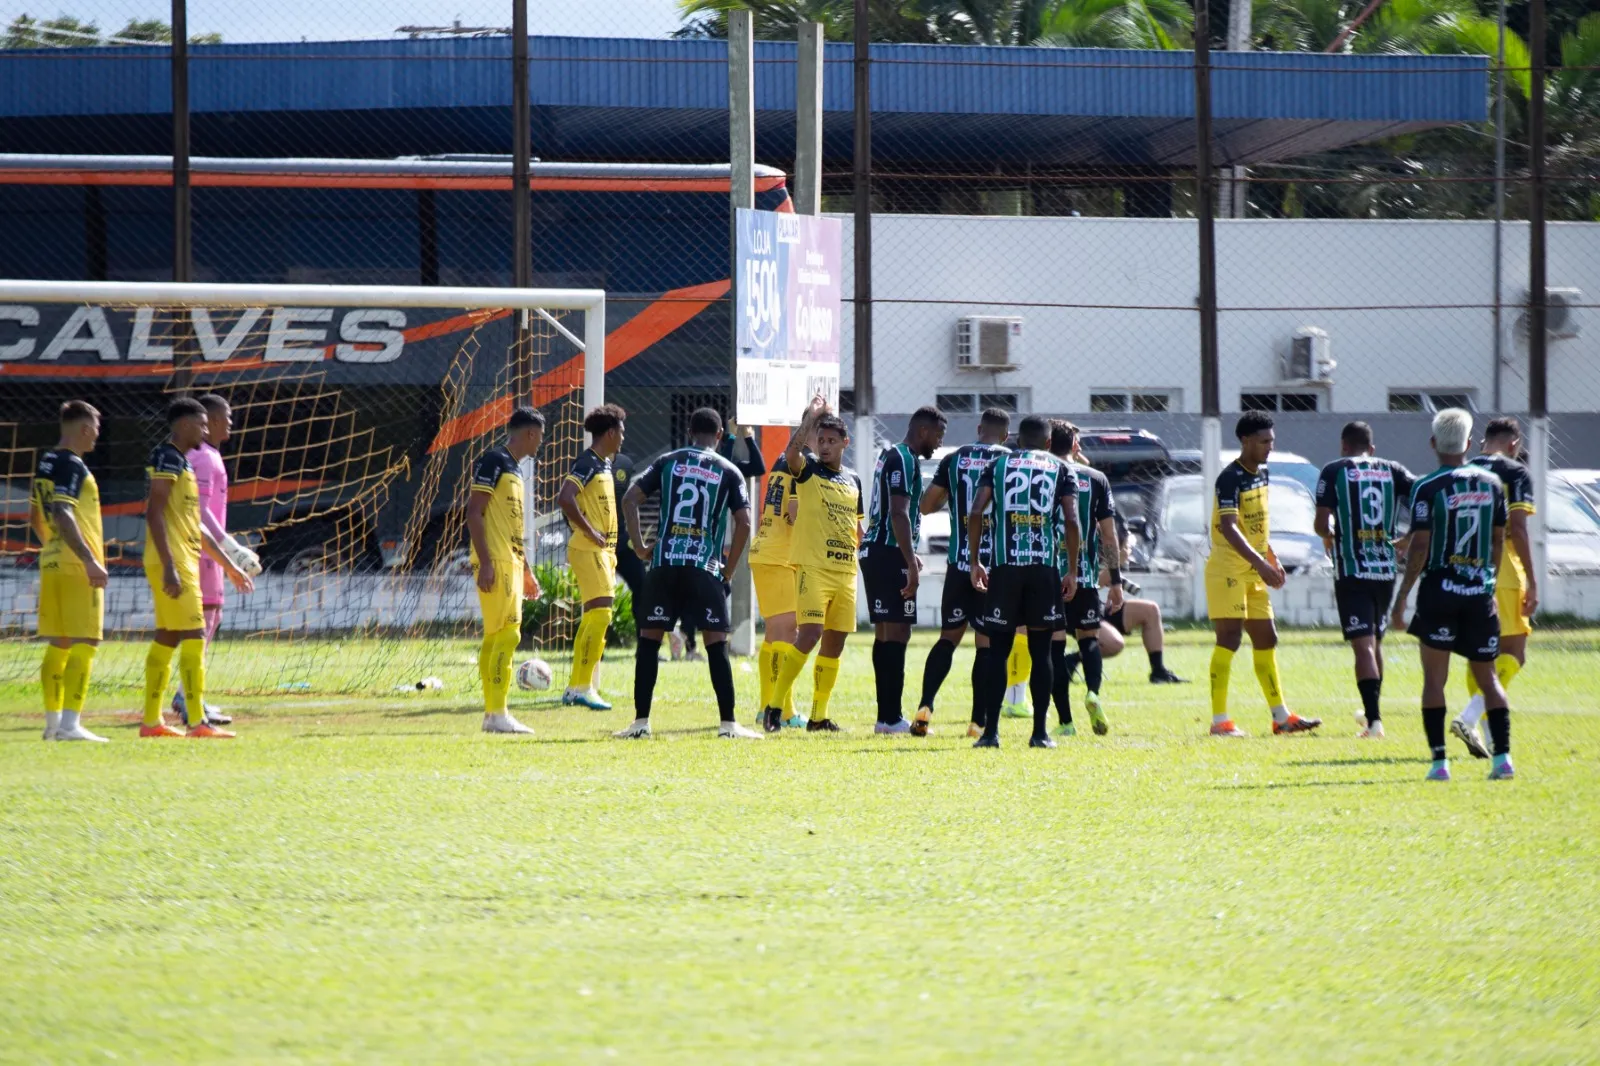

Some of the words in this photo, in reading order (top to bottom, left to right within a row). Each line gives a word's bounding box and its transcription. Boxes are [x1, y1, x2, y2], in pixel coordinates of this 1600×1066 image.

[753, 229, 771, 255] LOJA
[673, 482, 710, 528] 21
[1004, 471, 1055, 513] 23
[1362, 486, 1382, 526] 3
[1455, 508, 1480, 554] 7
[664, 552, 704, 562] Unimed
[1011, 549, 1050, 559] Unimed
